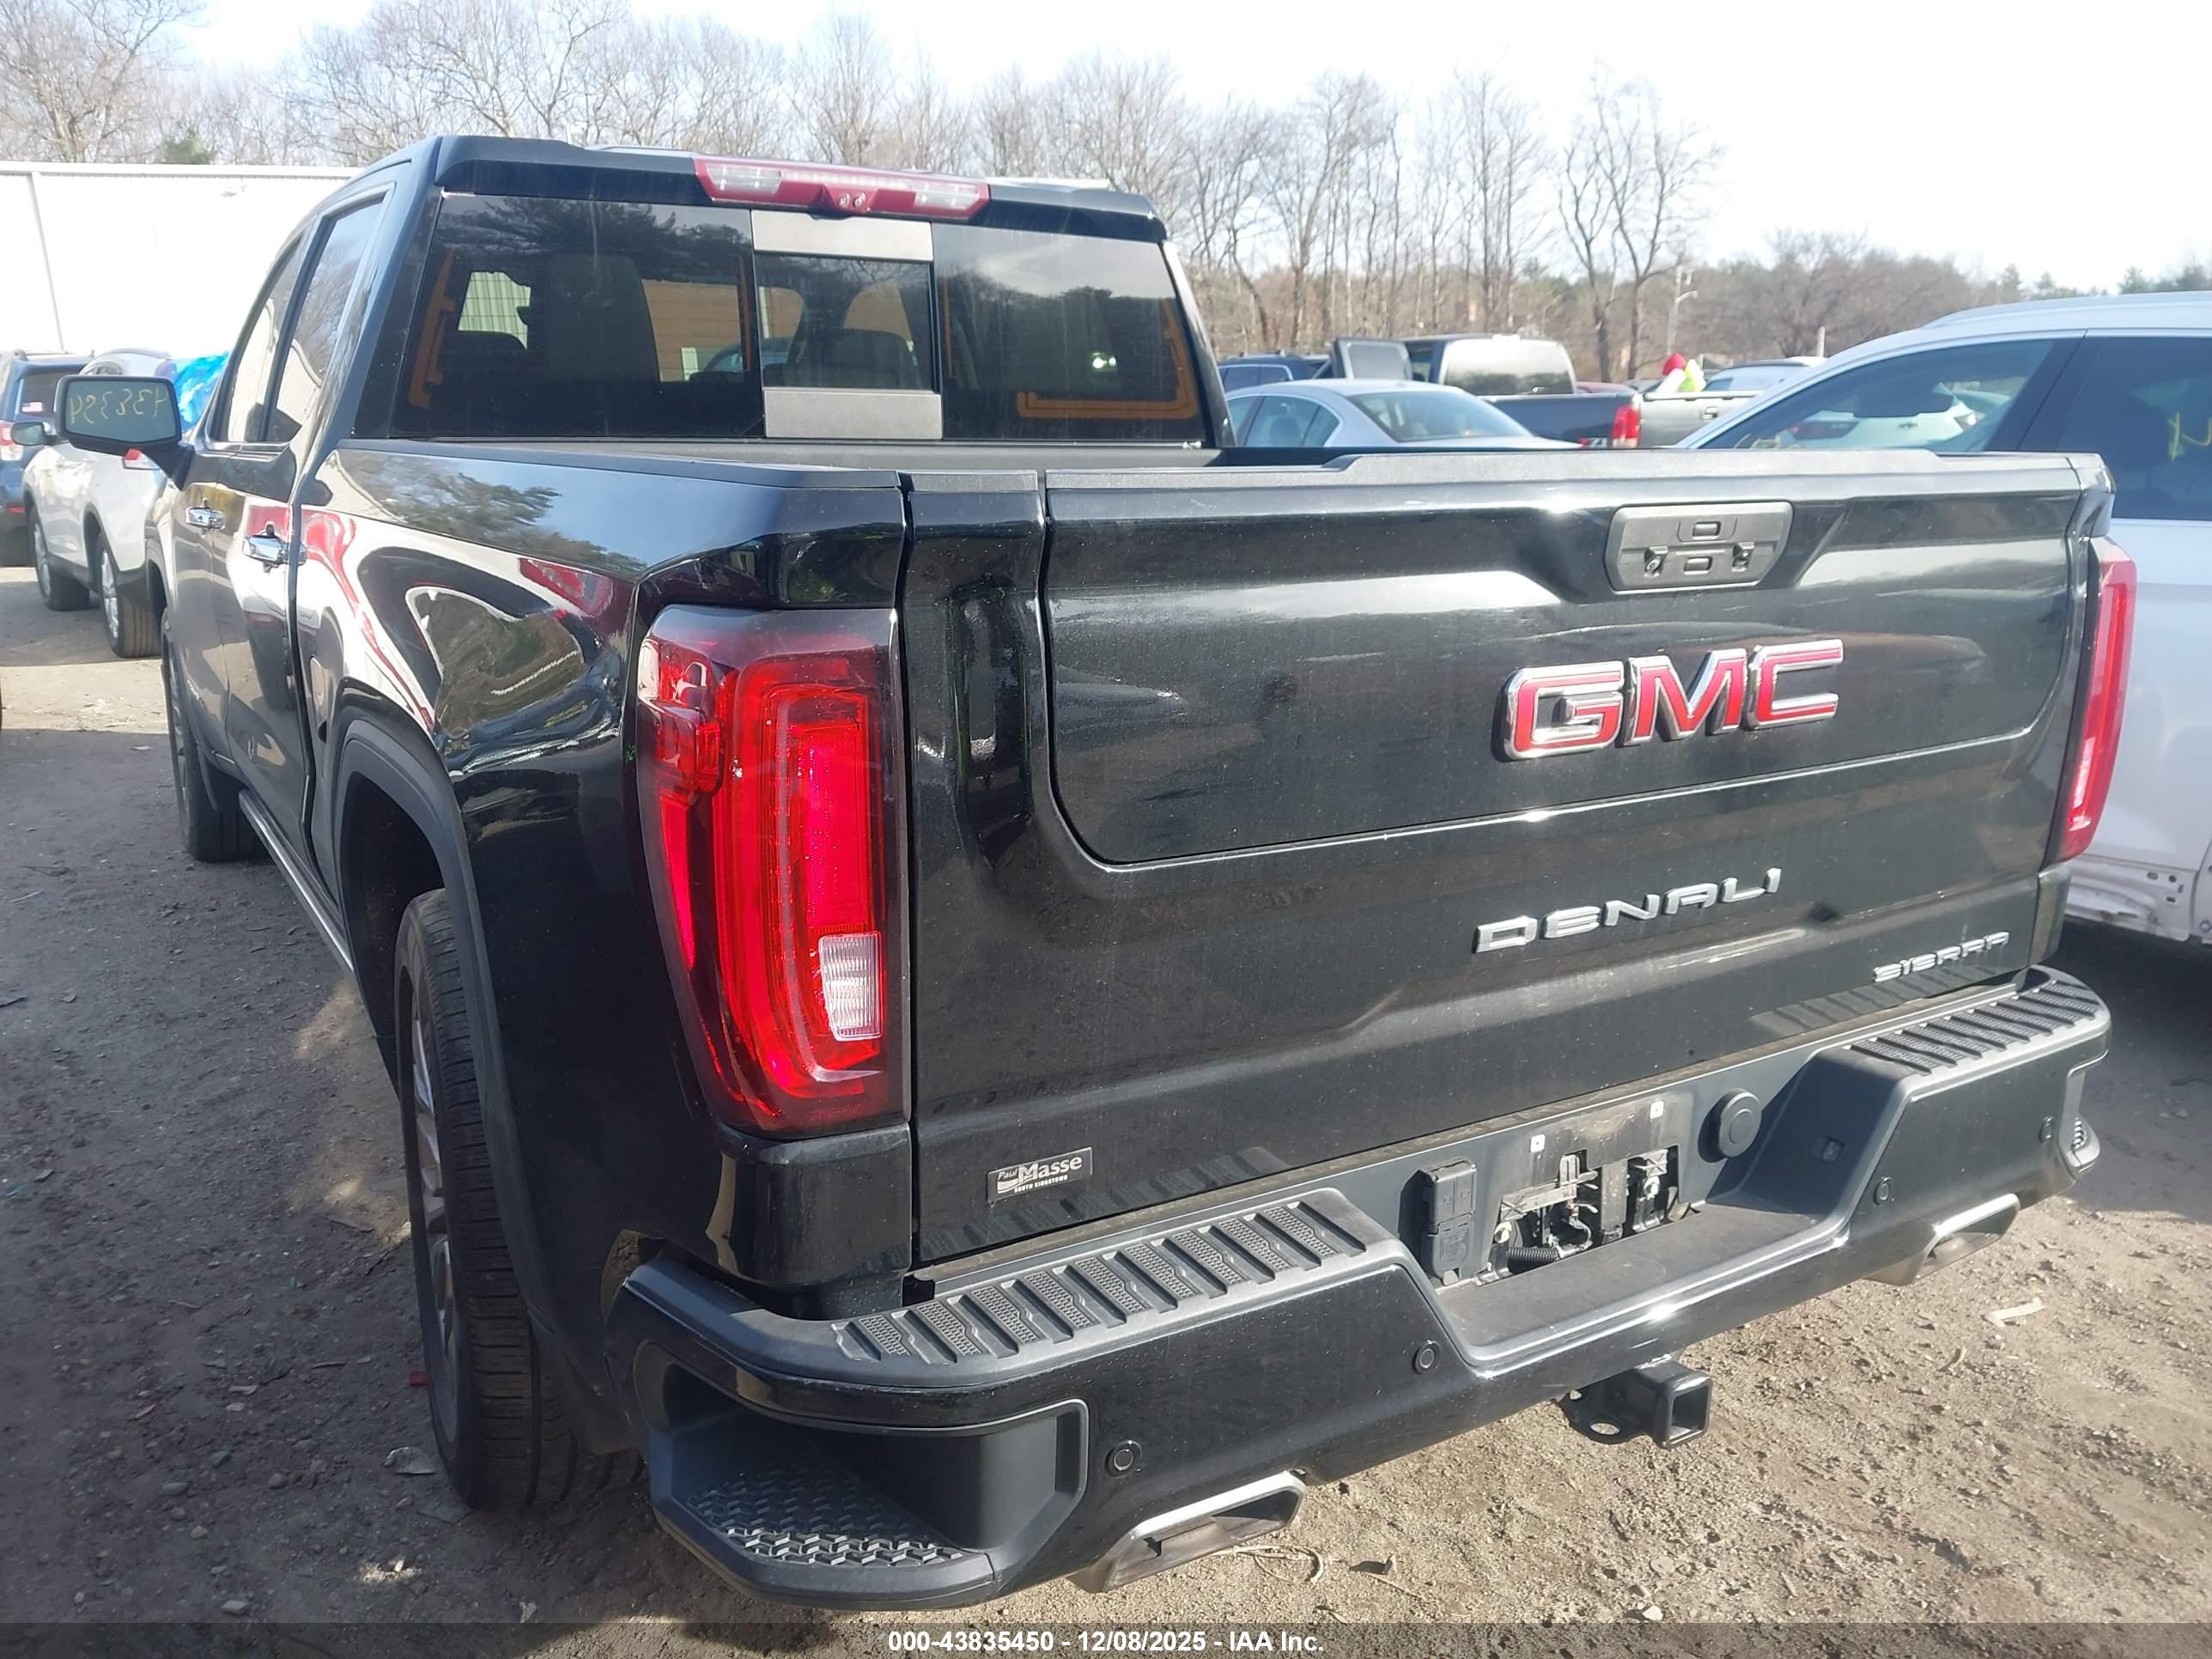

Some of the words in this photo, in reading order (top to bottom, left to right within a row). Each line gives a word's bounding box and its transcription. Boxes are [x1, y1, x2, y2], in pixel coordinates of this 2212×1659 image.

[1504, 639, 1844, 761] GMC
[1474, 867, 1782, 954] DENALI
[1873, 932, 2009, 982] SIERRA
[998, 1168, 1018, 1181] Paul
[1018, 1156, 1082, 1182] Masse
